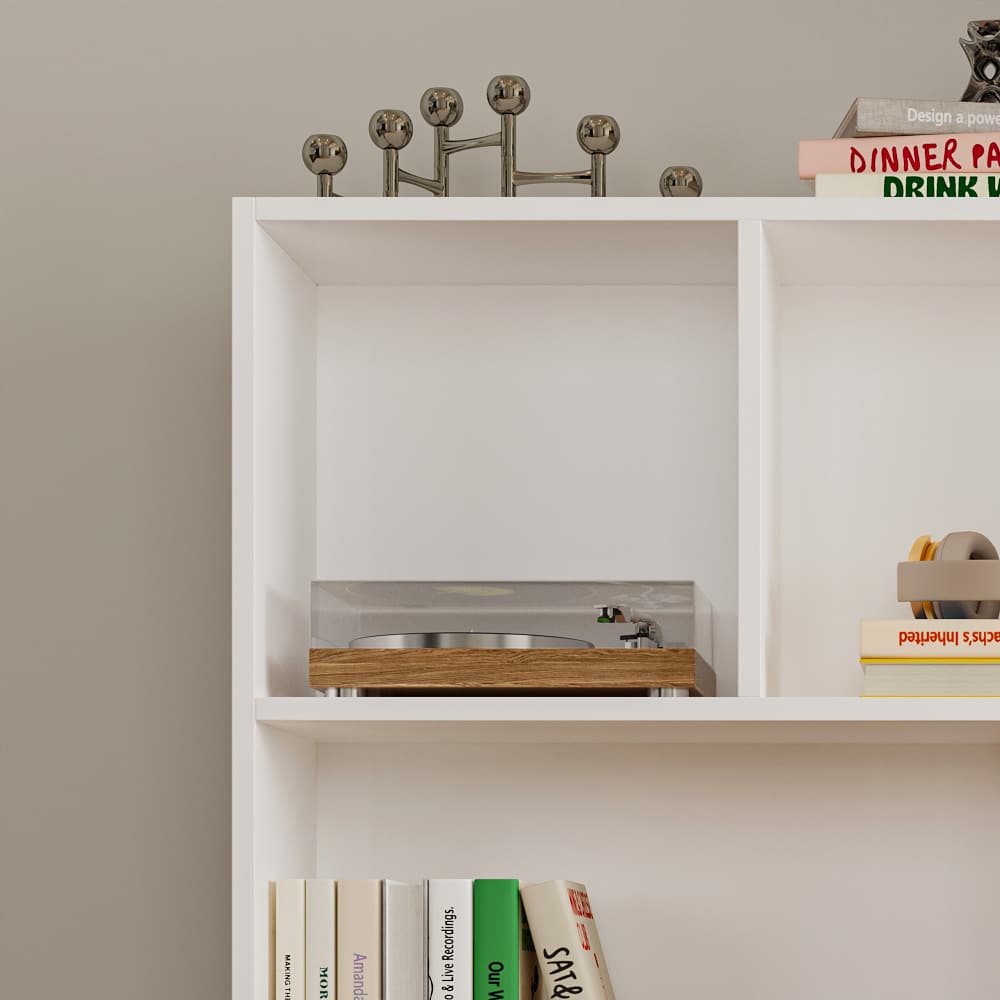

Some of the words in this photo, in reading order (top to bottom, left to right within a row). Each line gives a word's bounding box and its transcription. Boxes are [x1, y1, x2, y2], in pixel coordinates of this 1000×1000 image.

[908, 108, 953, 126] Design
[956, 113, 963, 123] a
[851, 139, 961, 173] DINNER
[899, 632, 958, 646] Inherited
[441, 907, 456, 960] Recordings.
[442, 964, 453, 981] Live
[488, 962, 504, 987] Our
